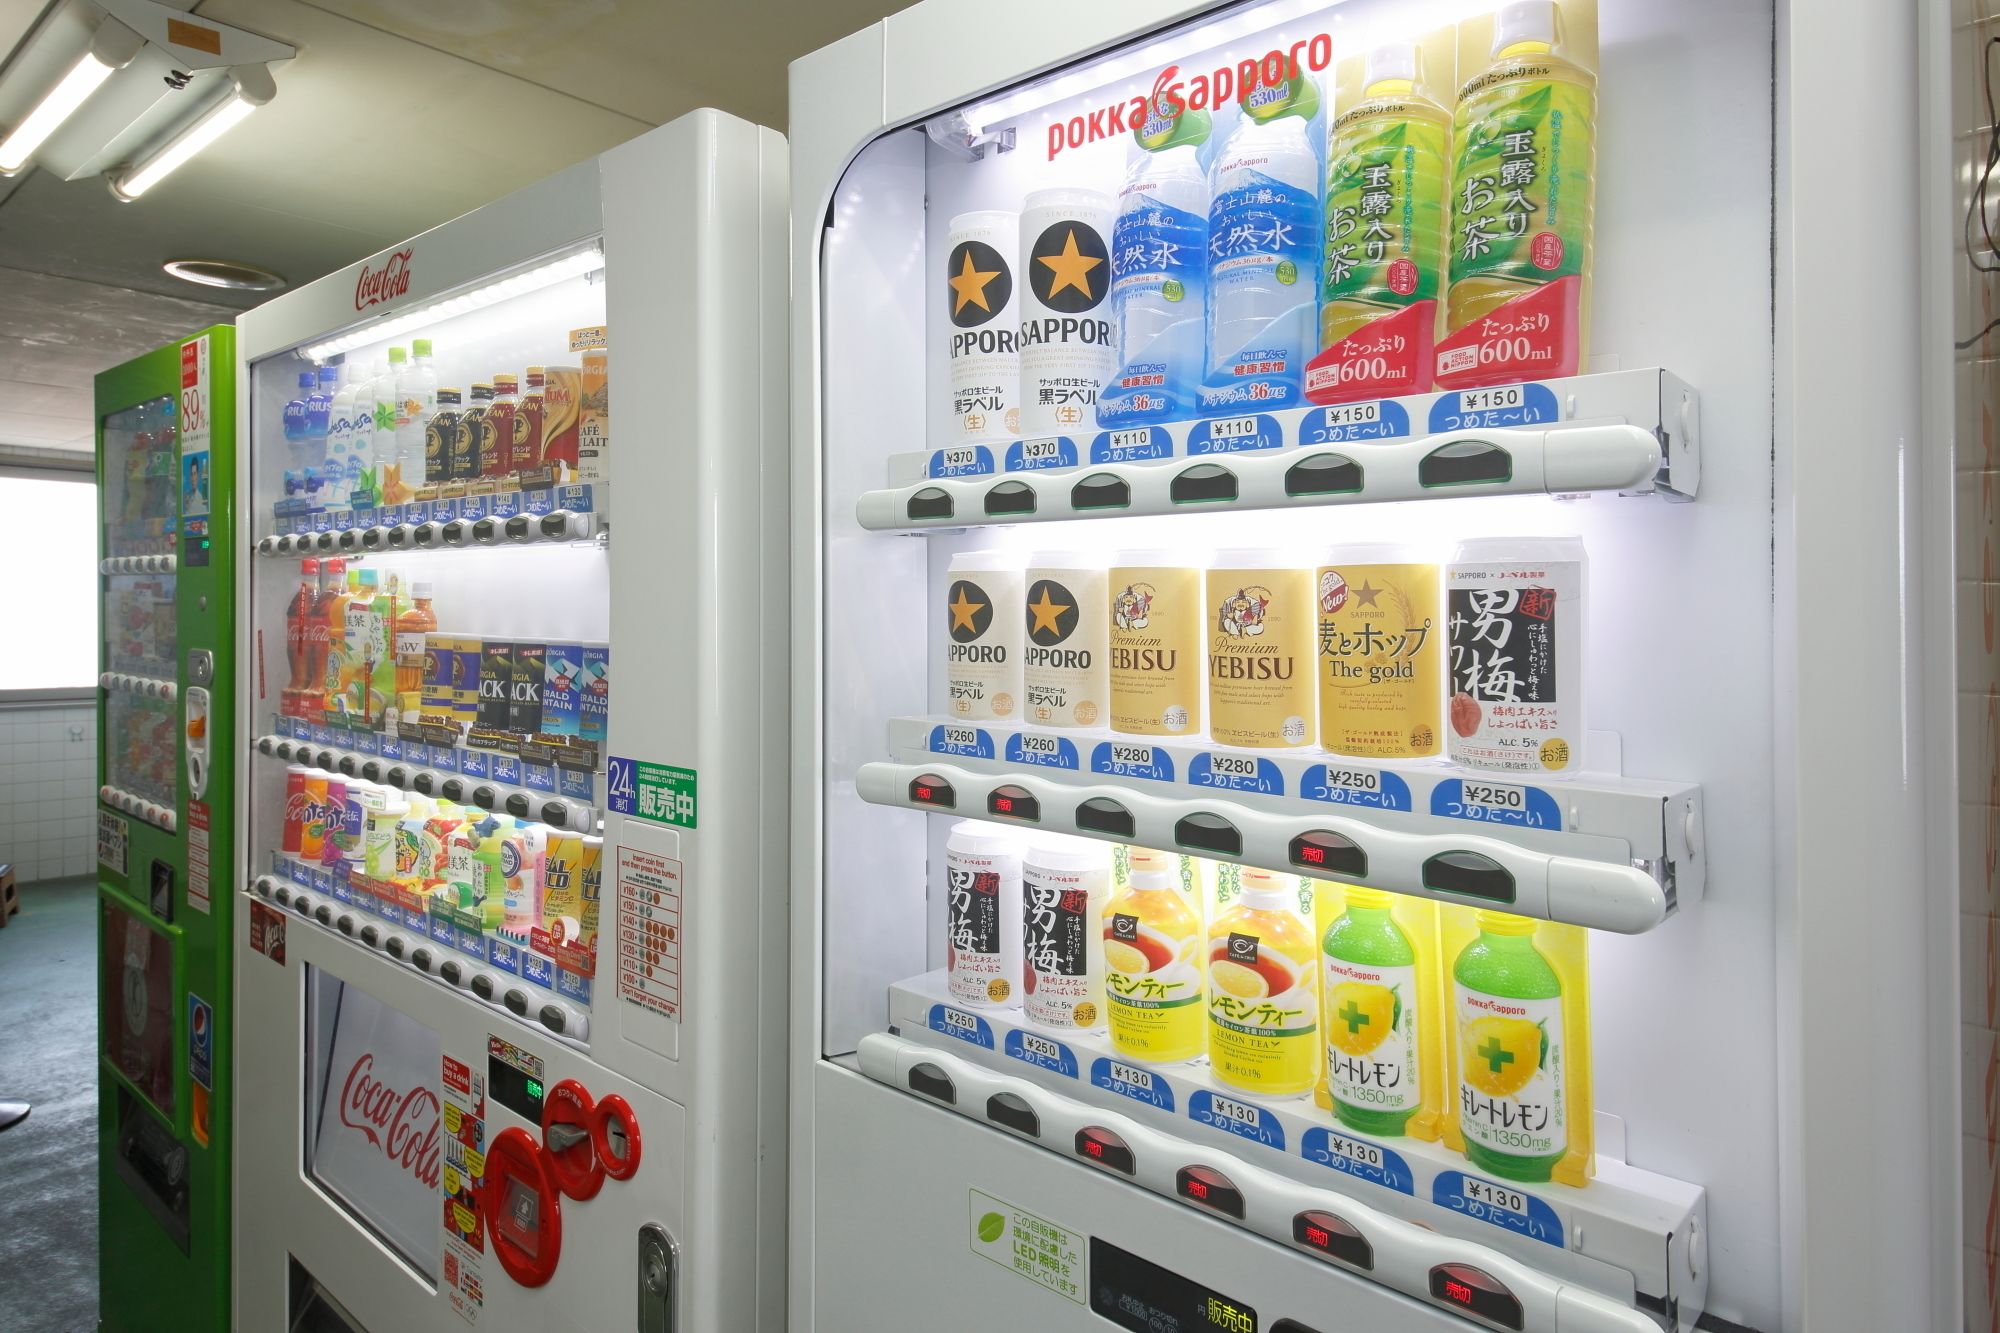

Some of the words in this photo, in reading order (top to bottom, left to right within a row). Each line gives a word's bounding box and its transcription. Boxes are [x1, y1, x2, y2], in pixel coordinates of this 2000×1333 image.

[1500, 129, 1539, 238] 玉露入り
[1361, 164, 1392, 263] 玉露入り
[1461, 177, 1500, 261] お茶
[1209, 221, 1296, 262] 天然水
[1329, 208, 1360, 286] お茶
[356, 247, 414, 311] Coca-Cola
[1482, 313, 1551, 337] たっぷり
[1342, 335, 1406, 357] たっぷり
[1479, 337, 1552, 364] 600ml
[1235, 362, 1285, 376] 健康習慣
[1340, 357, 1407, 382] 600ml
[1122, 375, 1164, 388] 健康習慣
[955, 396, 1003, 415] 黒ラベル
[1467, 390, 1518, 409] ¥150
[1331, 406, 1375, 423] ¥150
[1445, 407, 1540, 430] つめた〜い
[1114, 431, 1147, 446] ¥110
[1214, 420, 1254, 436] ¥110
[1313, 422, 1394, 442] つめた〜い
[1025, 442, 1056, 457] ¥370
[1100, 445, 1162, 462] つめた〜い
[1199, 434, 1270, 453] つめた〜い
[946, 450, 973, 463] ¥370
[1350, 611, 1385, 619] SAPPORO
[1213, 636, 1279, 654] Premium
[1319, 618, 1432, 657] 麦とホップ
[1464, 589, 1525, 703] 男梅
[1209, 654, 1294, 680] YEBISU
[1329, 660, 1363, 678] The
[1370, 661, 1414, 684] gold
[1163, 712, 1188, 725] お酒
[1283, 721, 1305, 737] お酒
[946, 729, 974, 743] ¥260
[1024, 737, 1055, 752] ¥260
[1410, 731, 1433, 747] お酒
[1522, 738, 1538, 748] 5%
[1114, 747, 1150, 763] ¥280
[1540, 746, 1569, 762] お酒
[1213, 758, 1254, 775] ¥280
[1329, 770, 1376, 790] ¥250
[639, 783, 694, 823] 販売中
[1465, 785, 1521, 807] ¥250
[1302, 847, 1323, 863] 売切
[1027, 885, 1064, 975] 男梅
[988, 983, 1010, 996] お酒
[1073, 1006, 1097, 1021] お酒
[1136, 1011, 1154, 1019] TEA
[1210, 987, 1302, 1026] レモンティー
[947, 1011, 974, 1028] ¥250
[1027, 1037, 1056, 1057] ¥250
[1216, 1029, 1245, 1044] LEMON
[1250, 1039, 1269, 1048] TEA
[1115, 1065, 1149, 1087] ¥130
[1328, 1045, 1400, 1088] キレートレモン
[1101, 1075, 1164, 1107] つめた〜い
[1351, 1085, 1404, 1104] 1350mg
[1216, 1100, 1256, 1123] ¥130
[1461, 1084, 1548, 1131] キレートレモン
[340, 1053, 441, 1189] Coca-Cola
[1201, 1111, 1272, 1144] つめた〜い
[1492, 1129, 1552, 1148] 1350mg
[1333, 1136, 1378, 1164] ¥130
[1315, 1150, 1398, 1187] つめた〜い
[1469, 1181, 1521, 1211] ¥130
[1450, 1194, 1546, 1239] つめた〜い
[1013, 1256, 1078, 1295] 使用しています
[1446, 1280, 1472, 1304] 売切
[1208, 1297, 1253, 1333] 販売中
